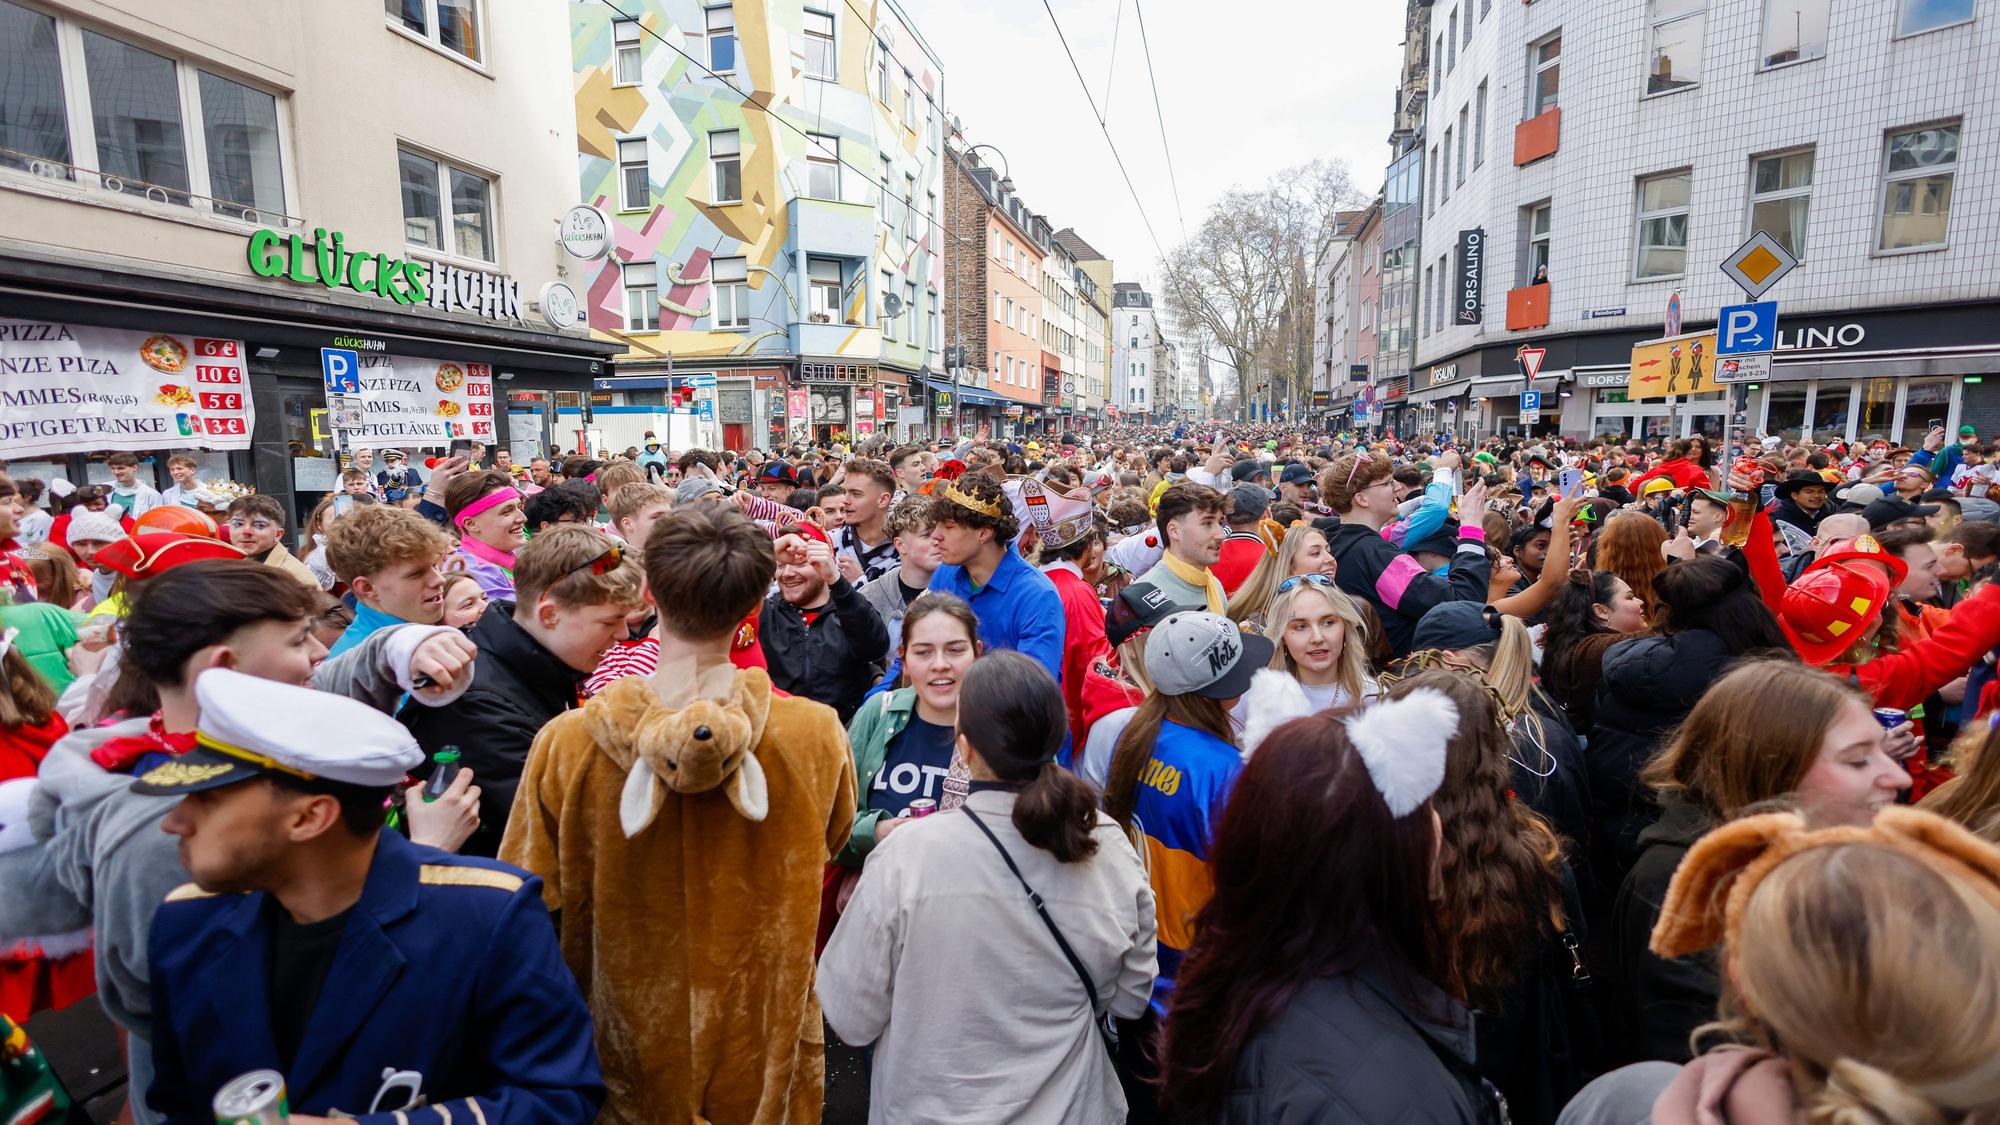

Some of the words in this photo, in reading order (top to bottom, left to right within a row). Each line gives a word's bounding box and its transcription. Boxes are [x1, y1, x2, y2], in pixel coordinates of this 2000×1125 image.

[564, 231, 603, 241] GLÜCKSHUHN
[249, 227, 524, 321] GLÜCKSHUHN
[1460, 233, 1480, 322] BORSALINO
[0, 324, 75, 341] PIZZA
[1726, 310, 1758, 348] P
[1776, 323, 1865, 350] LINO
[204, 341, 217, 355] 6
[222, 342, 234, 356] €
[334, 335, 386, 351] GLÜCKSHUHN
[199, 367, 222, 382] 10
[227, 368, 238, 383] €
[328, 354, 348, 388] P
[471, 365, 477, 376] 6
[469, 384, 480, 395] 10
[209, 394, 220, 409] 5
[225, 394, 236, 409] €
[1525, 393, 1536, 408] P
[475, 404, 481, 415] 5
[212, 419, 223, 434] 3
[227, 419, 239, 433] €
[477, 422, 483, 434] 3
[1209, 638, 1238, 677] Nets
